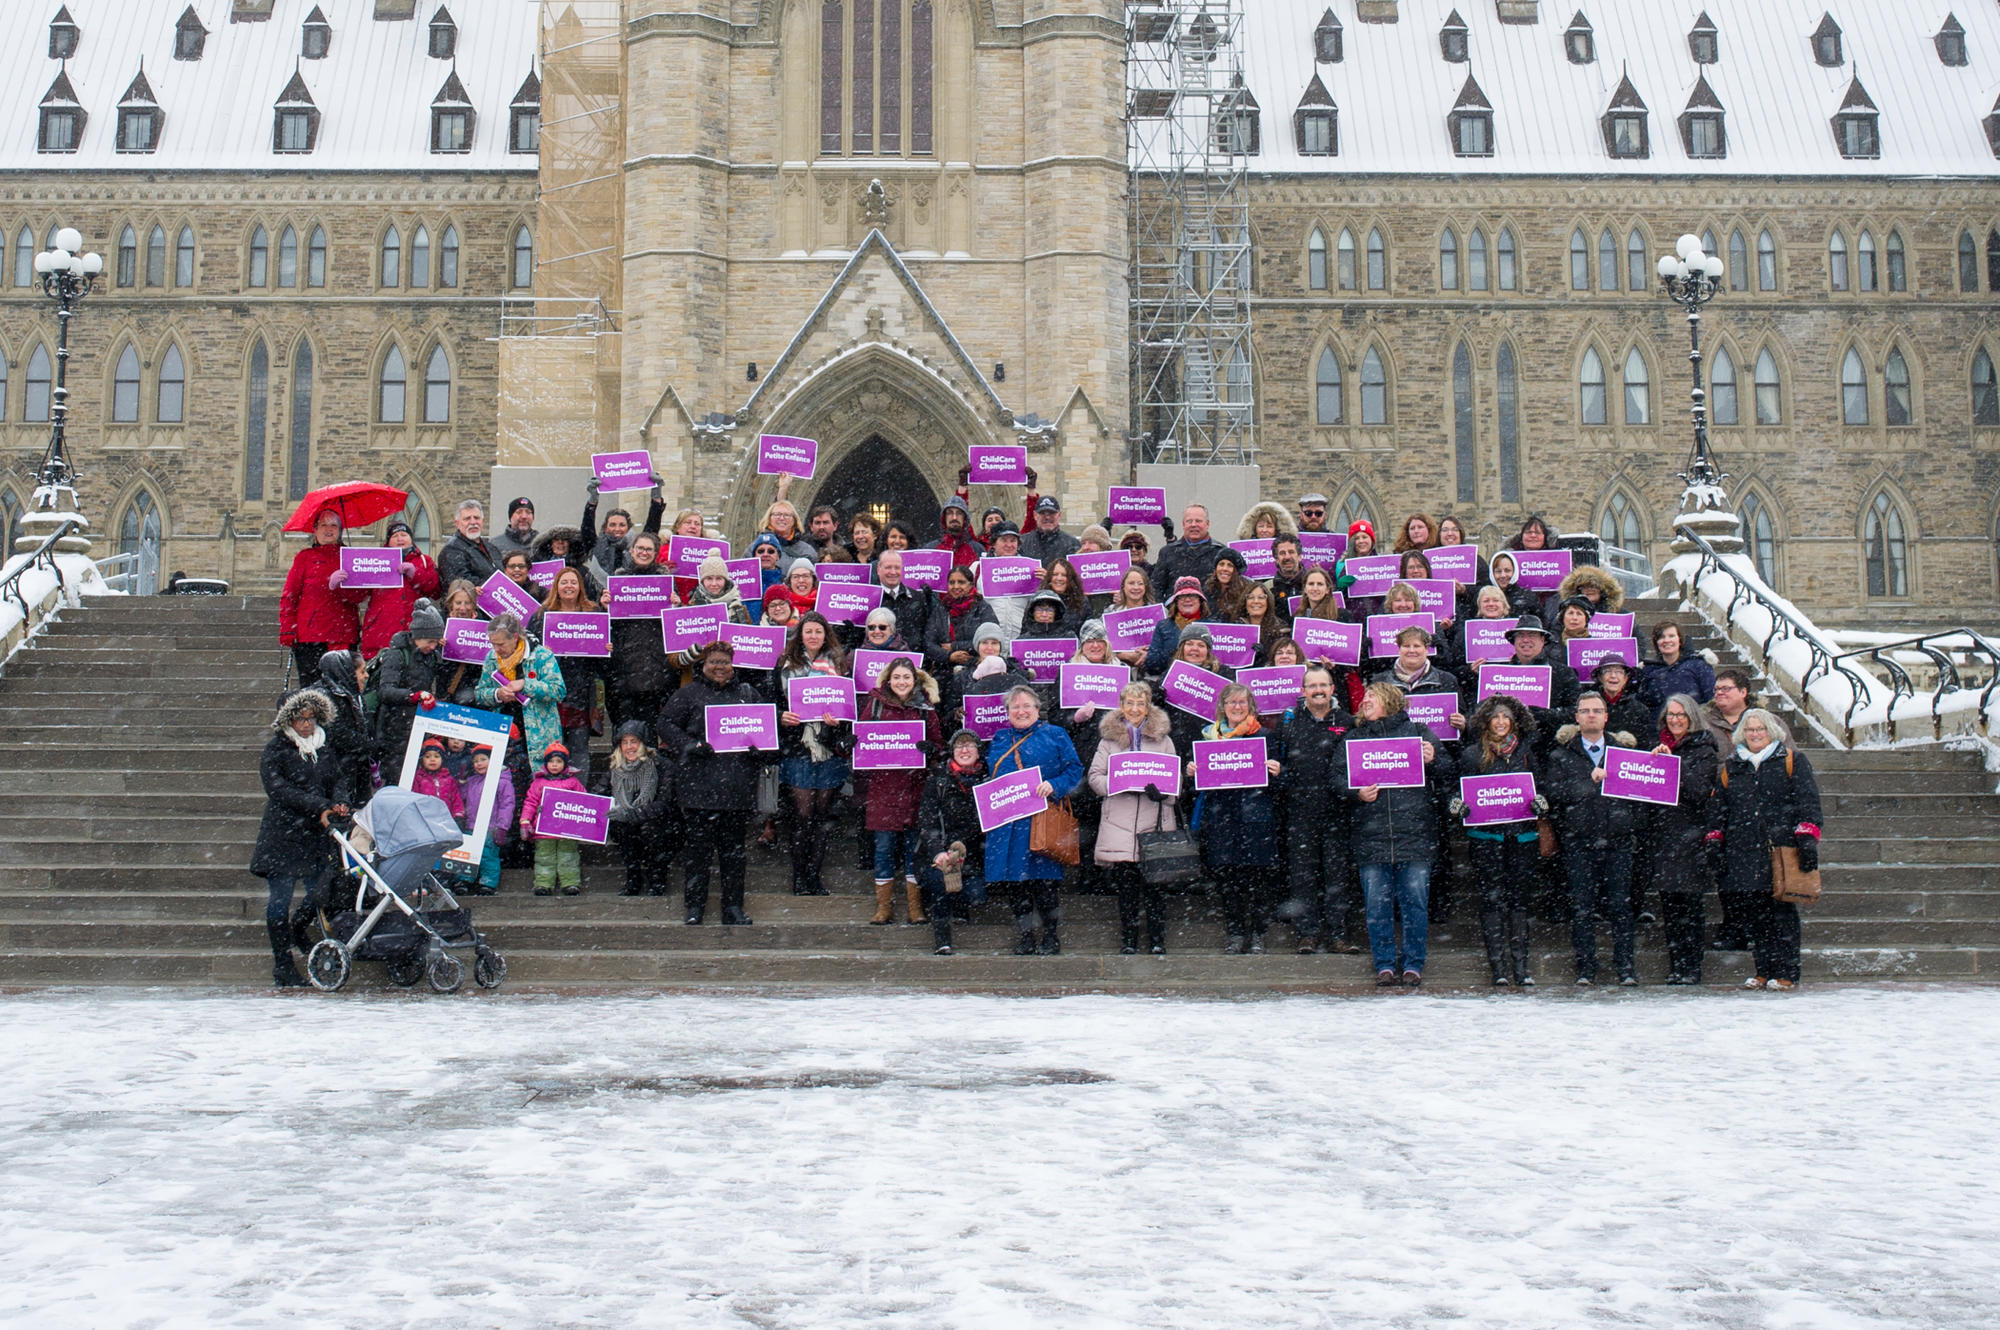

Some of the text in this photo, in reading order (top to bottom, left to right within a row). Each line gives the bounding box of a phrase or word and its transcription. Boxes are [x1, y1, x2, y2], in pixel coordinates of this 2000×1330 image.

[772, 444, 806, 454] Champion
[765, 452, 810, 463] Petite Enfance
[605, 462, 640, 470] Champion
[600, 468, 648, 478] Petite Enfance
[1120, 496, 1155, 504] Champion
[682, 547, 709, 557] ChildC
[352, 565, 391, 573] Champion
[1081, 562, 1118, 571] ChildCare
[1359, 564, 1396, 573] Champion
[1446, 561, 1470, 569] Enfance
[992, 566, 1030, 575] ChildCare
[1081, 570, 1120, 579] Champion
[1520, 568, 1559, 576] Champion
[992, 574, 1031, 582] Champion
[621, 586, 660, 595] Champion
[497, 586, 528, 614] ChildCare
[831, 594, 869, 603] ChildCare
[829, 602, 869, 610] Champion
[676, 616, 715, 627] ChildCare
[1118, 618, 1154, 629] ChildCare
[557, 622, 597, 632] Champion
[676, 625, 717, 635] Champion
[550, 631, 604, 639] Petite Enfance
[1212, 635, 1246, 644] hildCare
[1307, 630, 1348, 640] ChildCare
[456, 637, 492, 648] Champio
[732, 635, 772, 645] ChildCare
[1306, 637, 1348, 648] Champion
[1024, 651, 1064, 659] ChildCare
[1074, 675, 1116, 684] ChildCare
[1178, 673, 1215, 694] ChildCare
[1250, 678, 1292, 688] Champion
[1493, 675, 1536, 684] Champion
[802, 687, 844, 696] ChildCare
[1074, 683, 1117, 693] Champion
[1174, 680, 1213, 702] Champion
[1268, 686, 1302, 695] Enfance
[1485, 683, 1543, 692] Petite Enfance
[802, 696, 845, 704] Champion
[1408, 706, 1443, 714] hildCare
[720, 717, 762, 726] ChildCare
[720, 725, 764, 734] Champion
[867, 732, 910, 742] Champion
[860, 742, 884, 750] Petite
[1209, 752, 1252, 761] ChildCare
[1362, 751, 1408, 760] ChildCare
[1121, 761, 1165, 770] Champion
[1208, 761, 1253, 770] Champion
[1362, 760, 1409, 770] Champion
[1619, 762, 1665, 776] ChildCare
[1114, 768, 1173, 777] Petite Enfance
[1618, 771, 1665, 784] Champion
[989, 782, 1028, 801] ChildCare
[1477, 787, 1522, 797] ChildCare
[991, 789, 1030, 809] Champion
[1476, 796, 1524, 806] Champion
[555, 802, 596, 816] ChildCare
[552, 811, 596, 824] Champion
